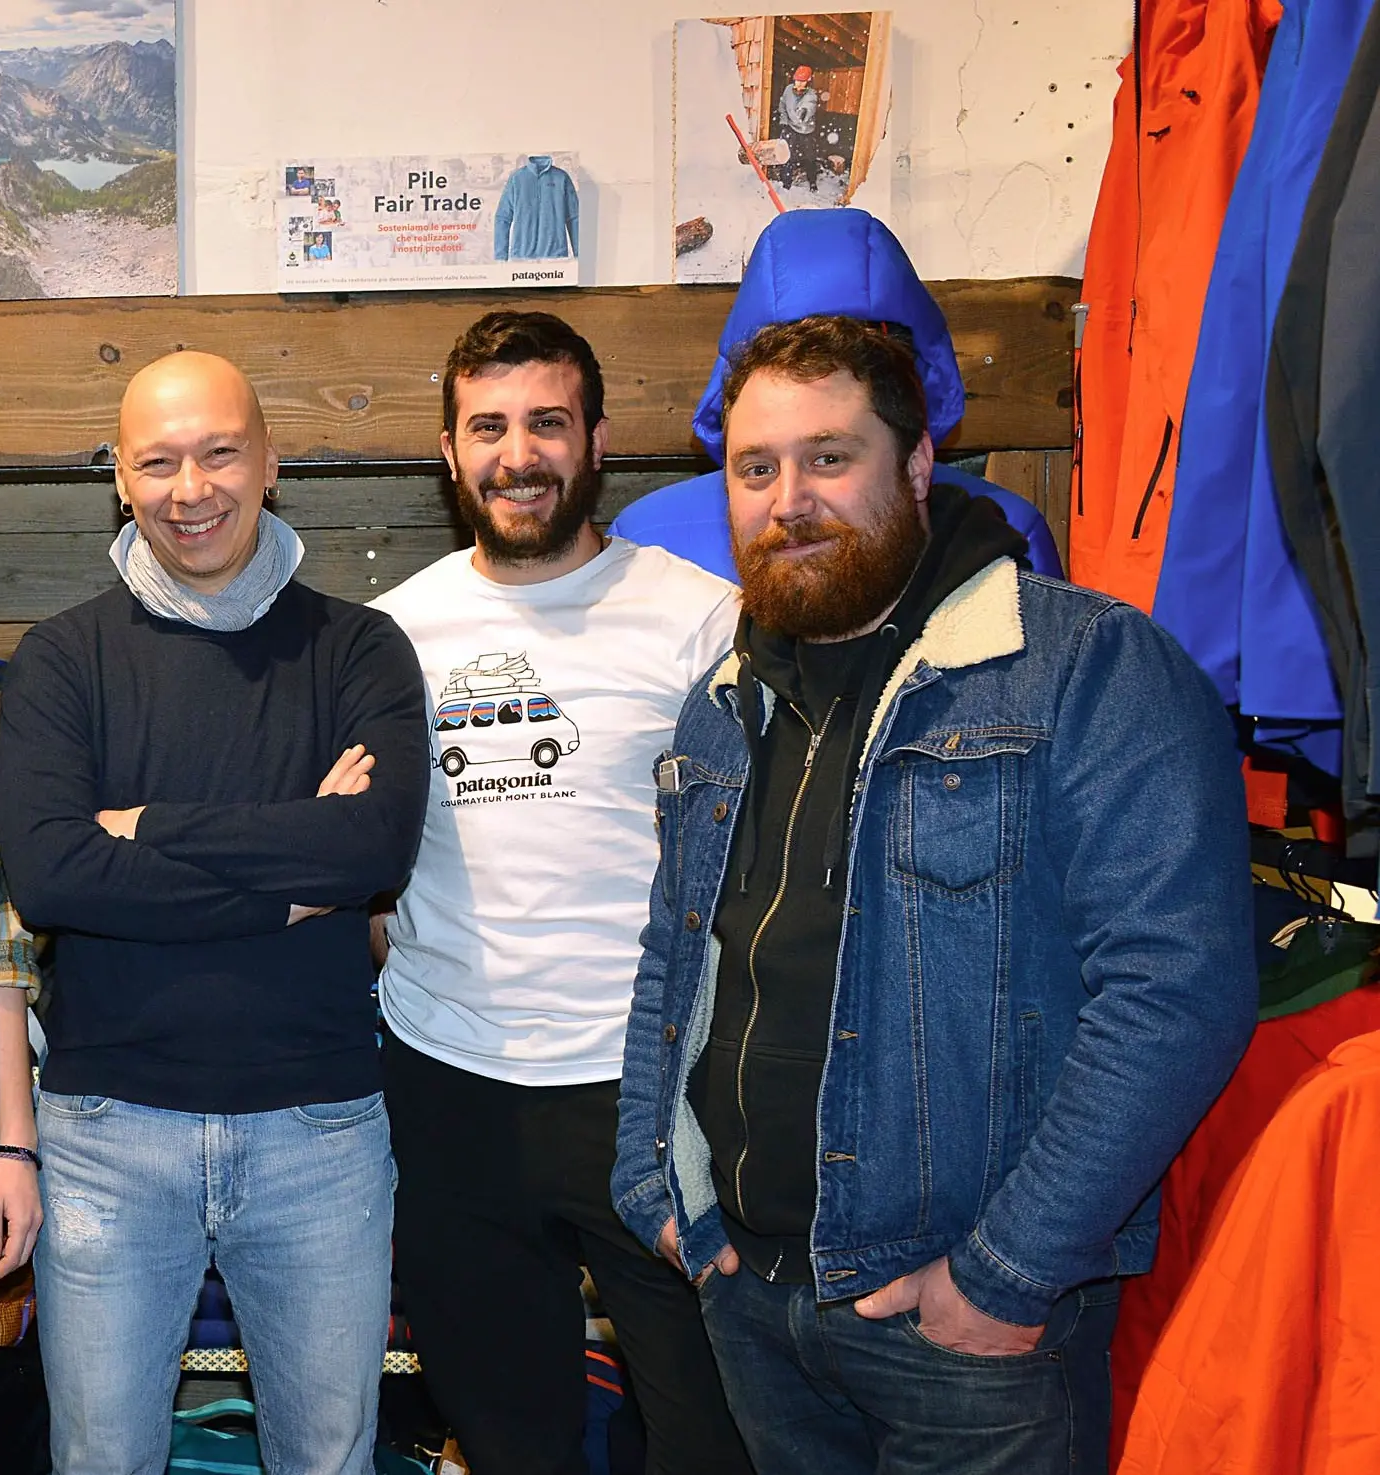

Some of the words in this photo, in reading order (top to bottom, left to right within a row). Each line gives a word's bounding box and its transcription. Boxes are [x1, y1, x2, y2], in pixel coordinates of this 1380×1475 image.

[408, 170, 447, 189] Pile
[374, 194, 414, 213] Fair
[420, 192, 481, 211] Trade
[377, 223, 429, 233] Sosteniamo
[431, 222, 439, 231] le
[441, 222, 477, 232] persone
[396, 232, 411, 243] che
[413, 233, 459, 242] realizzano
[398, 243, 423, 253] nostri
[425, 243, 462, 254] prodotti
[511, 269, 565, 282] patagonia
[456, 772, 552, 797] patagonia
[441, 795, 502, 808] COURMAYEUR
[505, 792, 537, 802] MONT
[540, 790, 577, 799] BLANC
